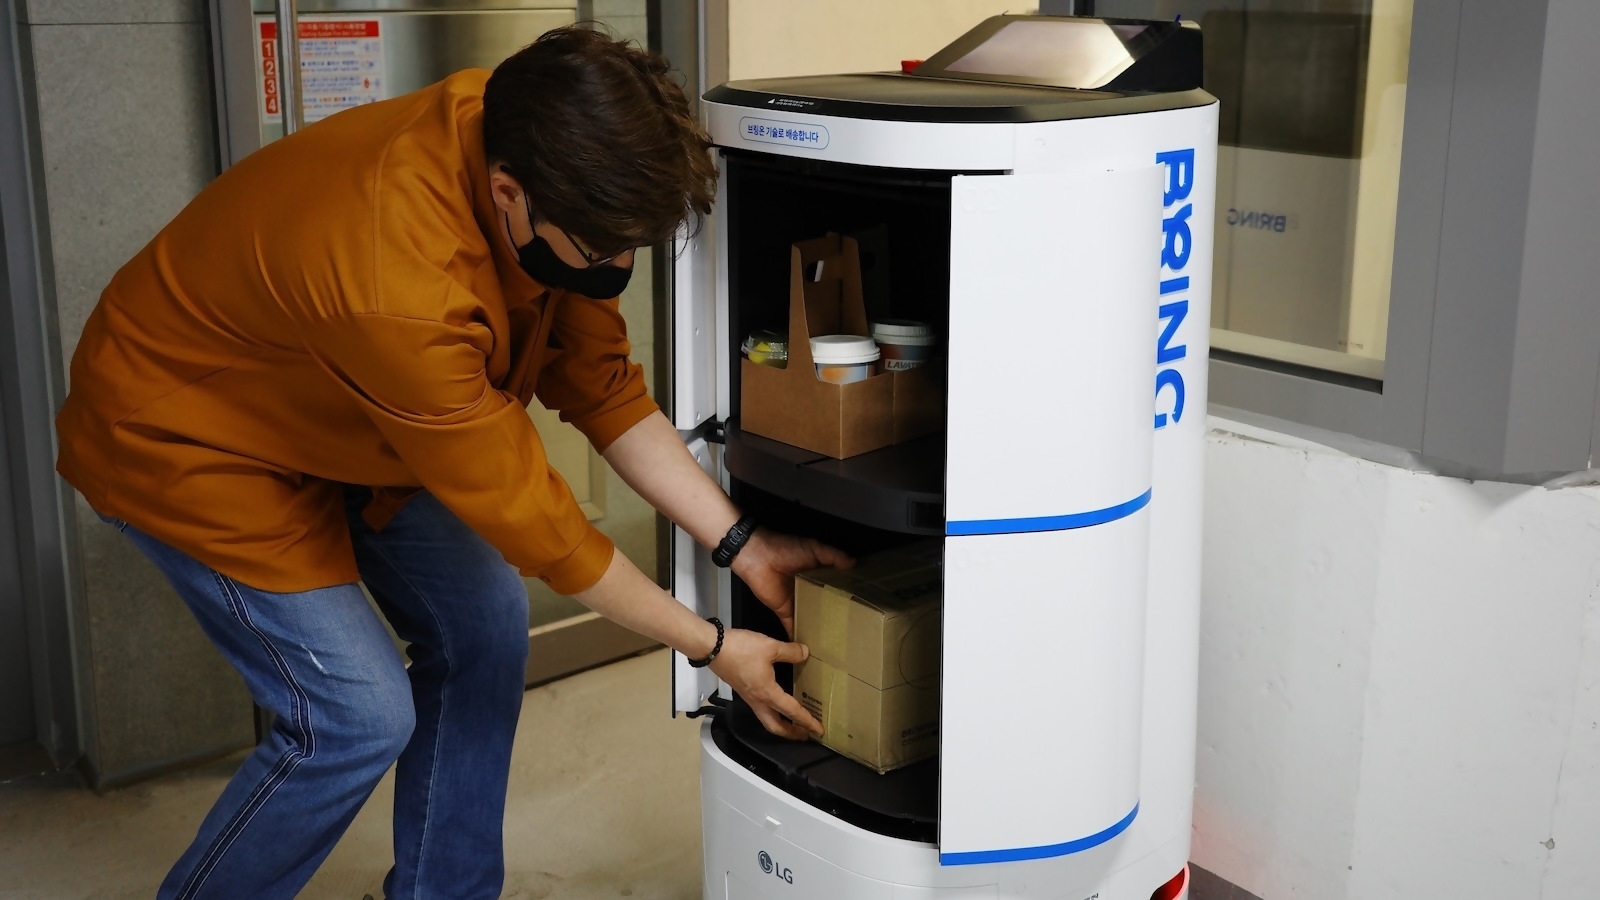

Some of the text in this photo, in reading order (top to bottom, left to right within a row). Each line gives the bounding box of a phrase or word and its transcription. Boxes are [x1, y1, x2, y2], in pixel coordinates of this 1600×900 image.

[265, 43, 272, 56] 1
[266, 62, 274, 75] 2
[267, 79, 275, 93] 3
[268, 99, 277, 112] 4
[747, 124, 819, 143] 브링온 기술로 배송합니다
[775, 862, 793, 884] LG
